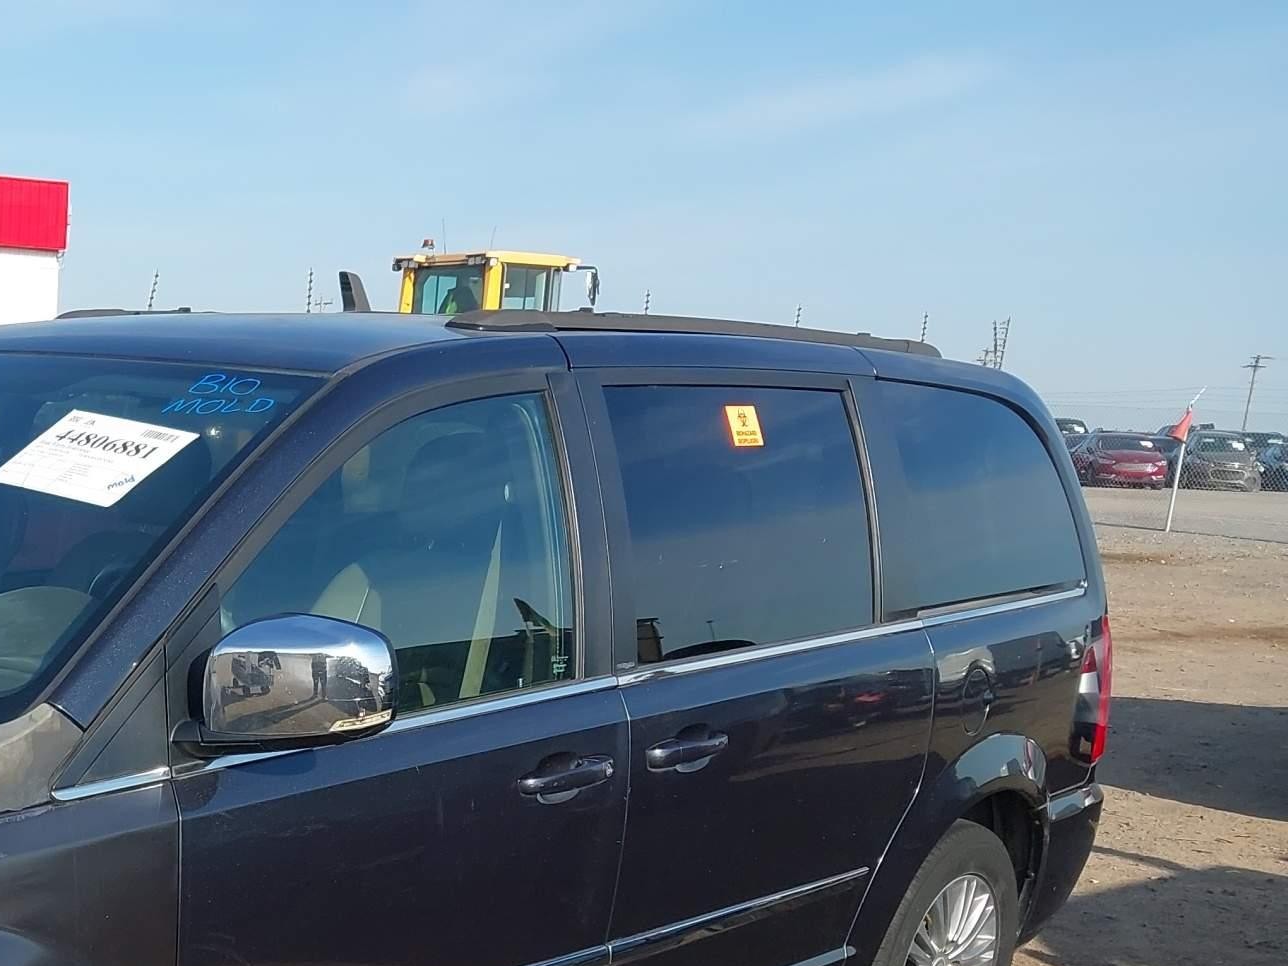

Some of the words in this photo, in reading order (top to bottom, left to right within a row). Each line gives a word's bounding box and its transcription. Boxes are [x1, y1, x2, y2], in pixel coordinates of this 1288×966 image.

[188, 374, 261, 395] BIO
[162, 398, 274, 415] MOLD
[56, 429, 159, 459] 44806881
